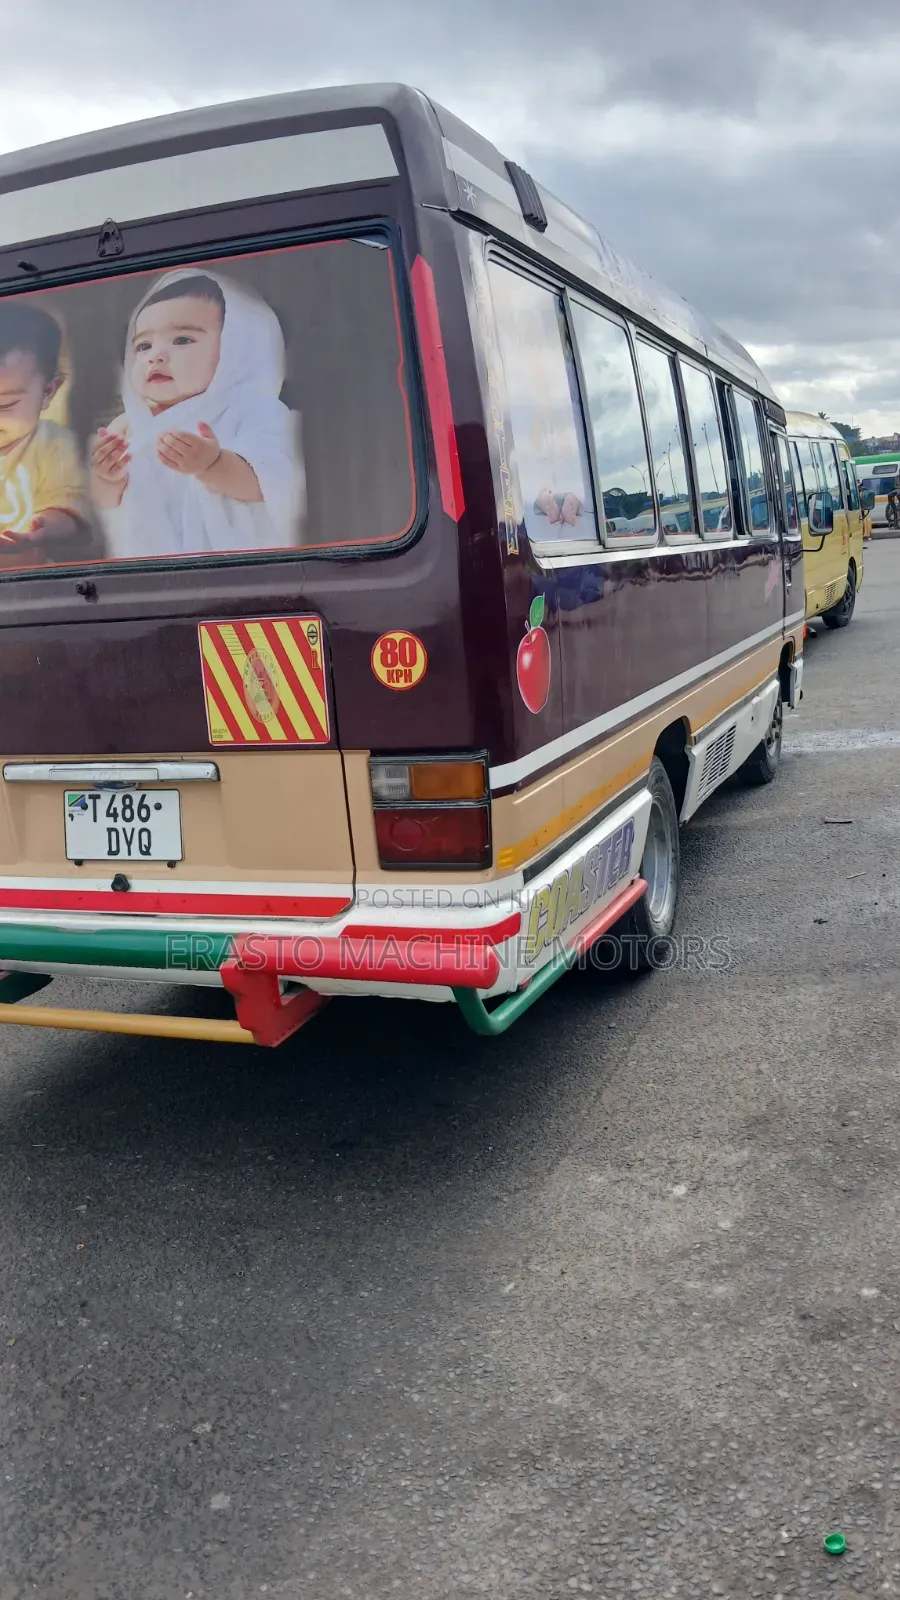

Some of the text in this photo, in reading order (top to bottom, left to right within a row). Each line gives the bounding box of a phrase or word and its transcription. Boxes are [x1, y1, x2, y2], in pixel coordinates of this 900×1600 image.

[380, 637, 418, 668] 80
[386, 668, 413, 684] KPH
[106, 827, 152, 856] DYQ
[524, 816, 635, 966] COASTER
